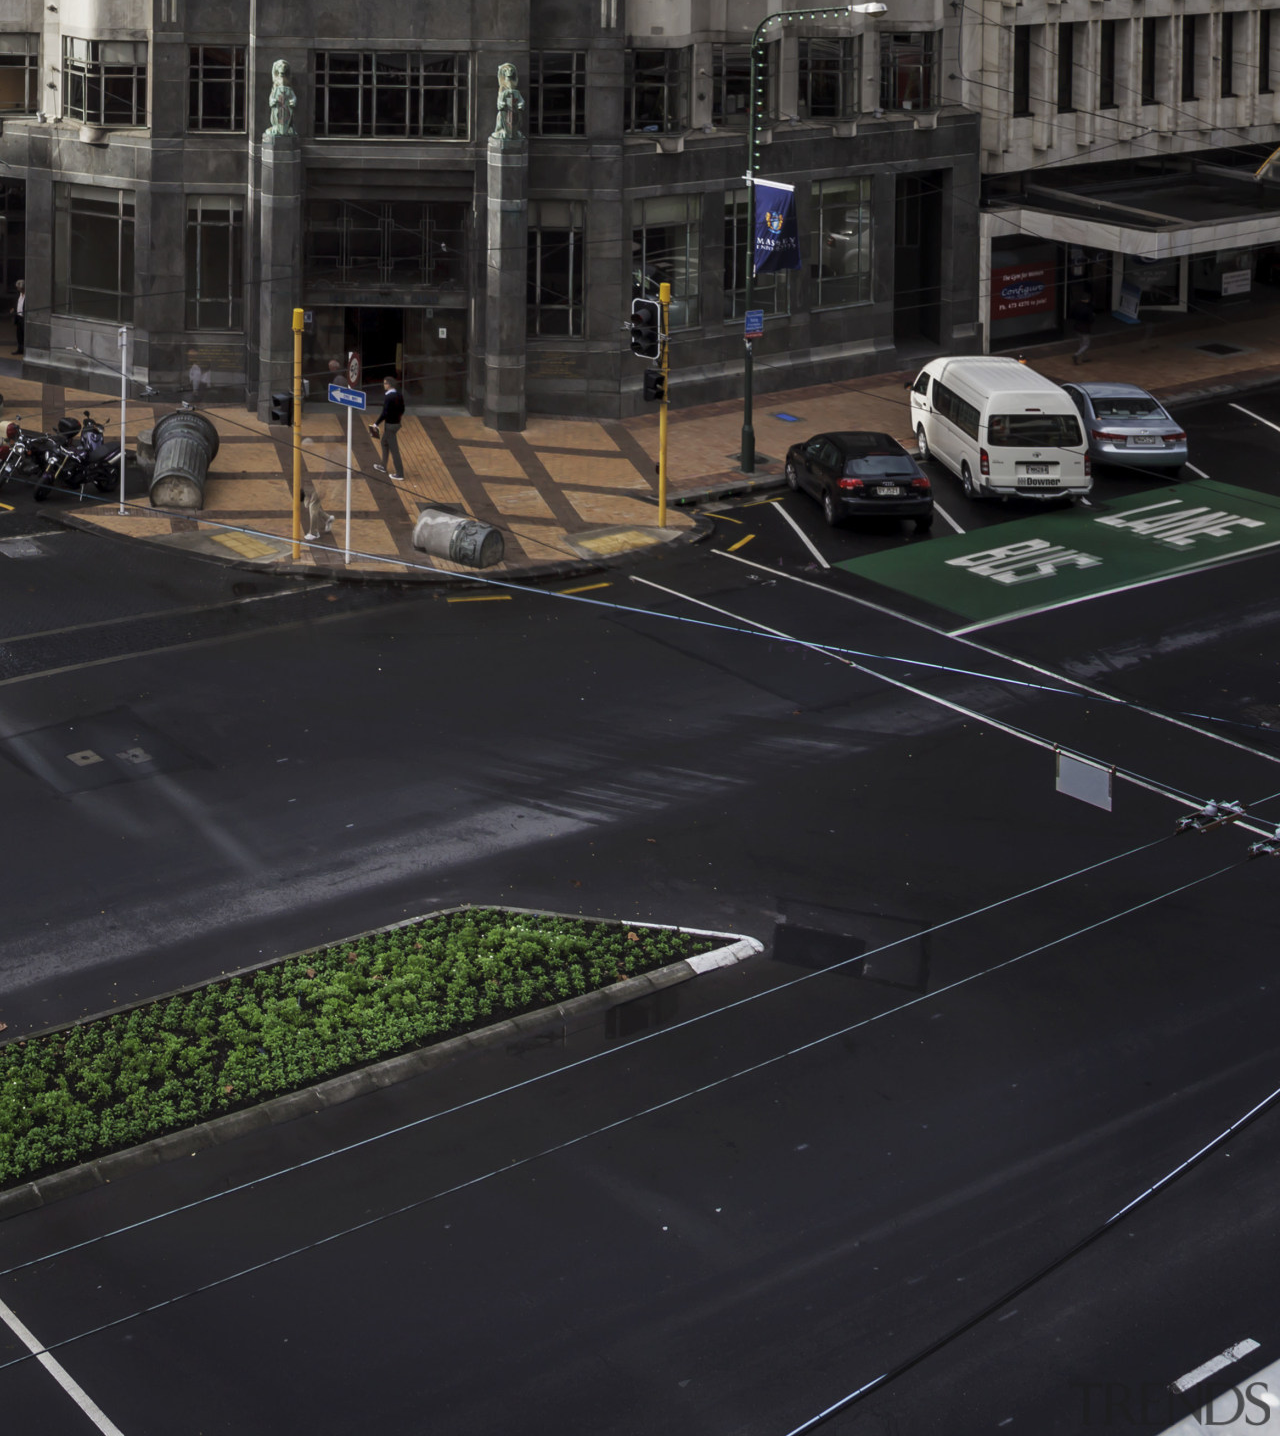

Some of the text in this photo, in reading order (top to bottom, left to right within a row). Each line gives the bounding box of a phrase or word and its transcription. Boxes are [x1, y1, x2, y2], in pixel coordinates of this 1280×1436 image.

[1027, 477, 1061, 486] Downer
[1093, 499, 1266, 549] LANE
[944, 538, 1103, 586] BUS
